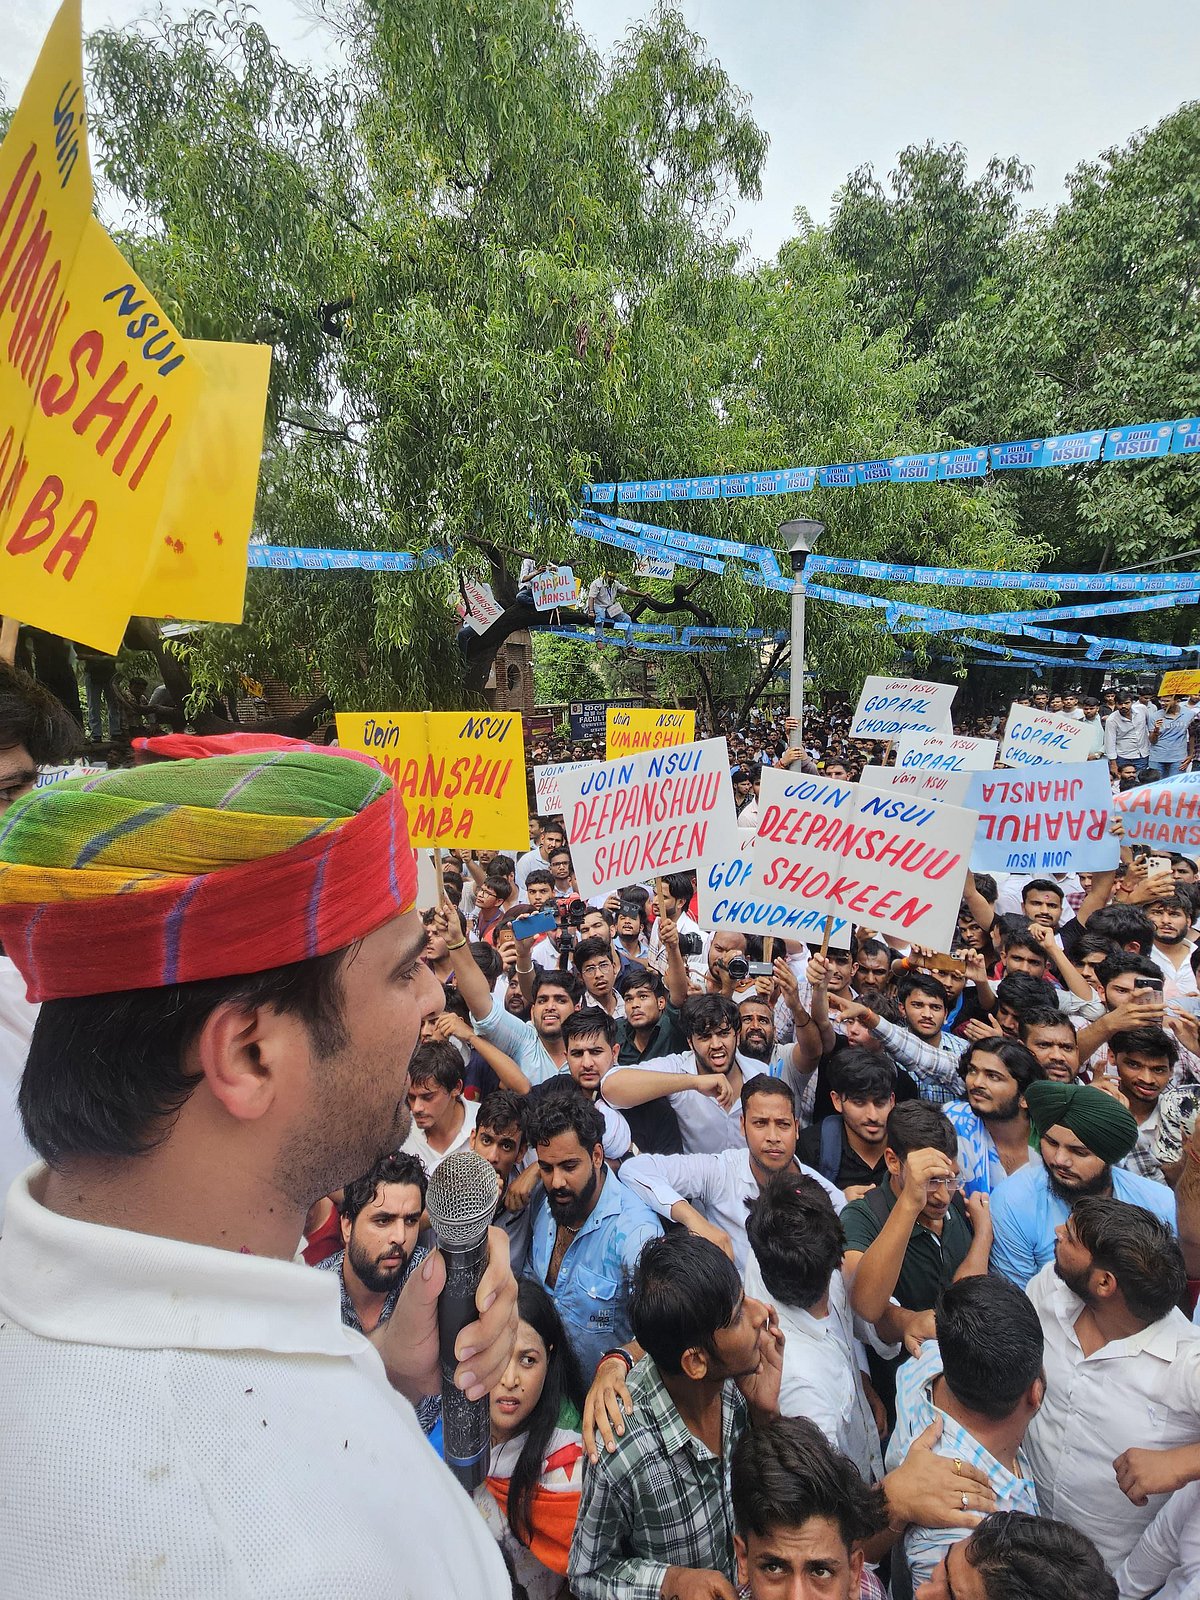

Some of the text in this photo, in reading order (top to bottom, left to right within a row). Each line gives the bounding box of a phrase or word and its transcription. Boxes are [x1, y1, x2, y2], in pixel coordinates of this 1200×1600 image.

[54, 80, 185, 377] Join NSUI
[1062, 439, 1085, 447] JOIN
[1128, 431, 1151, 440] JOIN
[1052, 446, 1091, 461] NSUI
[1115, 440, 1158, 455] NSUI
[1000, 452, 1032, 465] NSUI
[865, 468, 891, 480] NSUI
[900, 467, 928, 478] NSUI
[946, 462, 977, 475] NSUI
[787, 478, 809, 489] NSUI
[827, 473, 850, 483] NSUI
[671, 488, 688, 498] NSUI
[697, 487, 715, 496] NSUI
[726, 485, 745, 494] NSUI
[756, 483, 776, 492] NSUI
[695, 543, 713, 553] NSUI
[270, 558, 291, 566] NSUI
[303, 559, 323, 567] NSUI
[333, 559, 353, 567] NSUI
[889, 572, 907, 580] NSUI
[909, 684, 939, 695] NSUI
[864, 695, 931, 714] GOPAAL
[613, 712, 630, 726] Join
[655, 713, 685, 727] NSUI
[363, 717, 512, 748] Join NSUI
[1010, 723, 1073, 750] GOPAAL
[1055, 722, 1081, 736] NSUI
[610, 730, 685, 748] UMANSHII
[950, 739, 979, 751] NSUI
[901, 749, 966, 772] GOPAAL
[374, 753, 513, 799] MANSHII
[540, 767, 565, 777] JOIN
[581, 749, 703, 796] JOIN NSUI
[921, 776, 949, 791] NSUI
[982, 779, 1084, 804] JHANSLA
[569, 770, 722, 846] DEEPANSHUU
[784, 780, 936, 827] JOIN NSUI
[1113, 788, 1200, 819] RAAH
[978, 808, 1108, 842] RAAHUL
[757, 805, 961, 880] DEEPANSHUU
[592, 820, 709, 886] SHOKEEN
[1006, 850, 1072, 868] JOIN NSUI
[763, 857, 932, 928] SHOKEEN
[712, 899, 848, 937] CHOUDHARY
